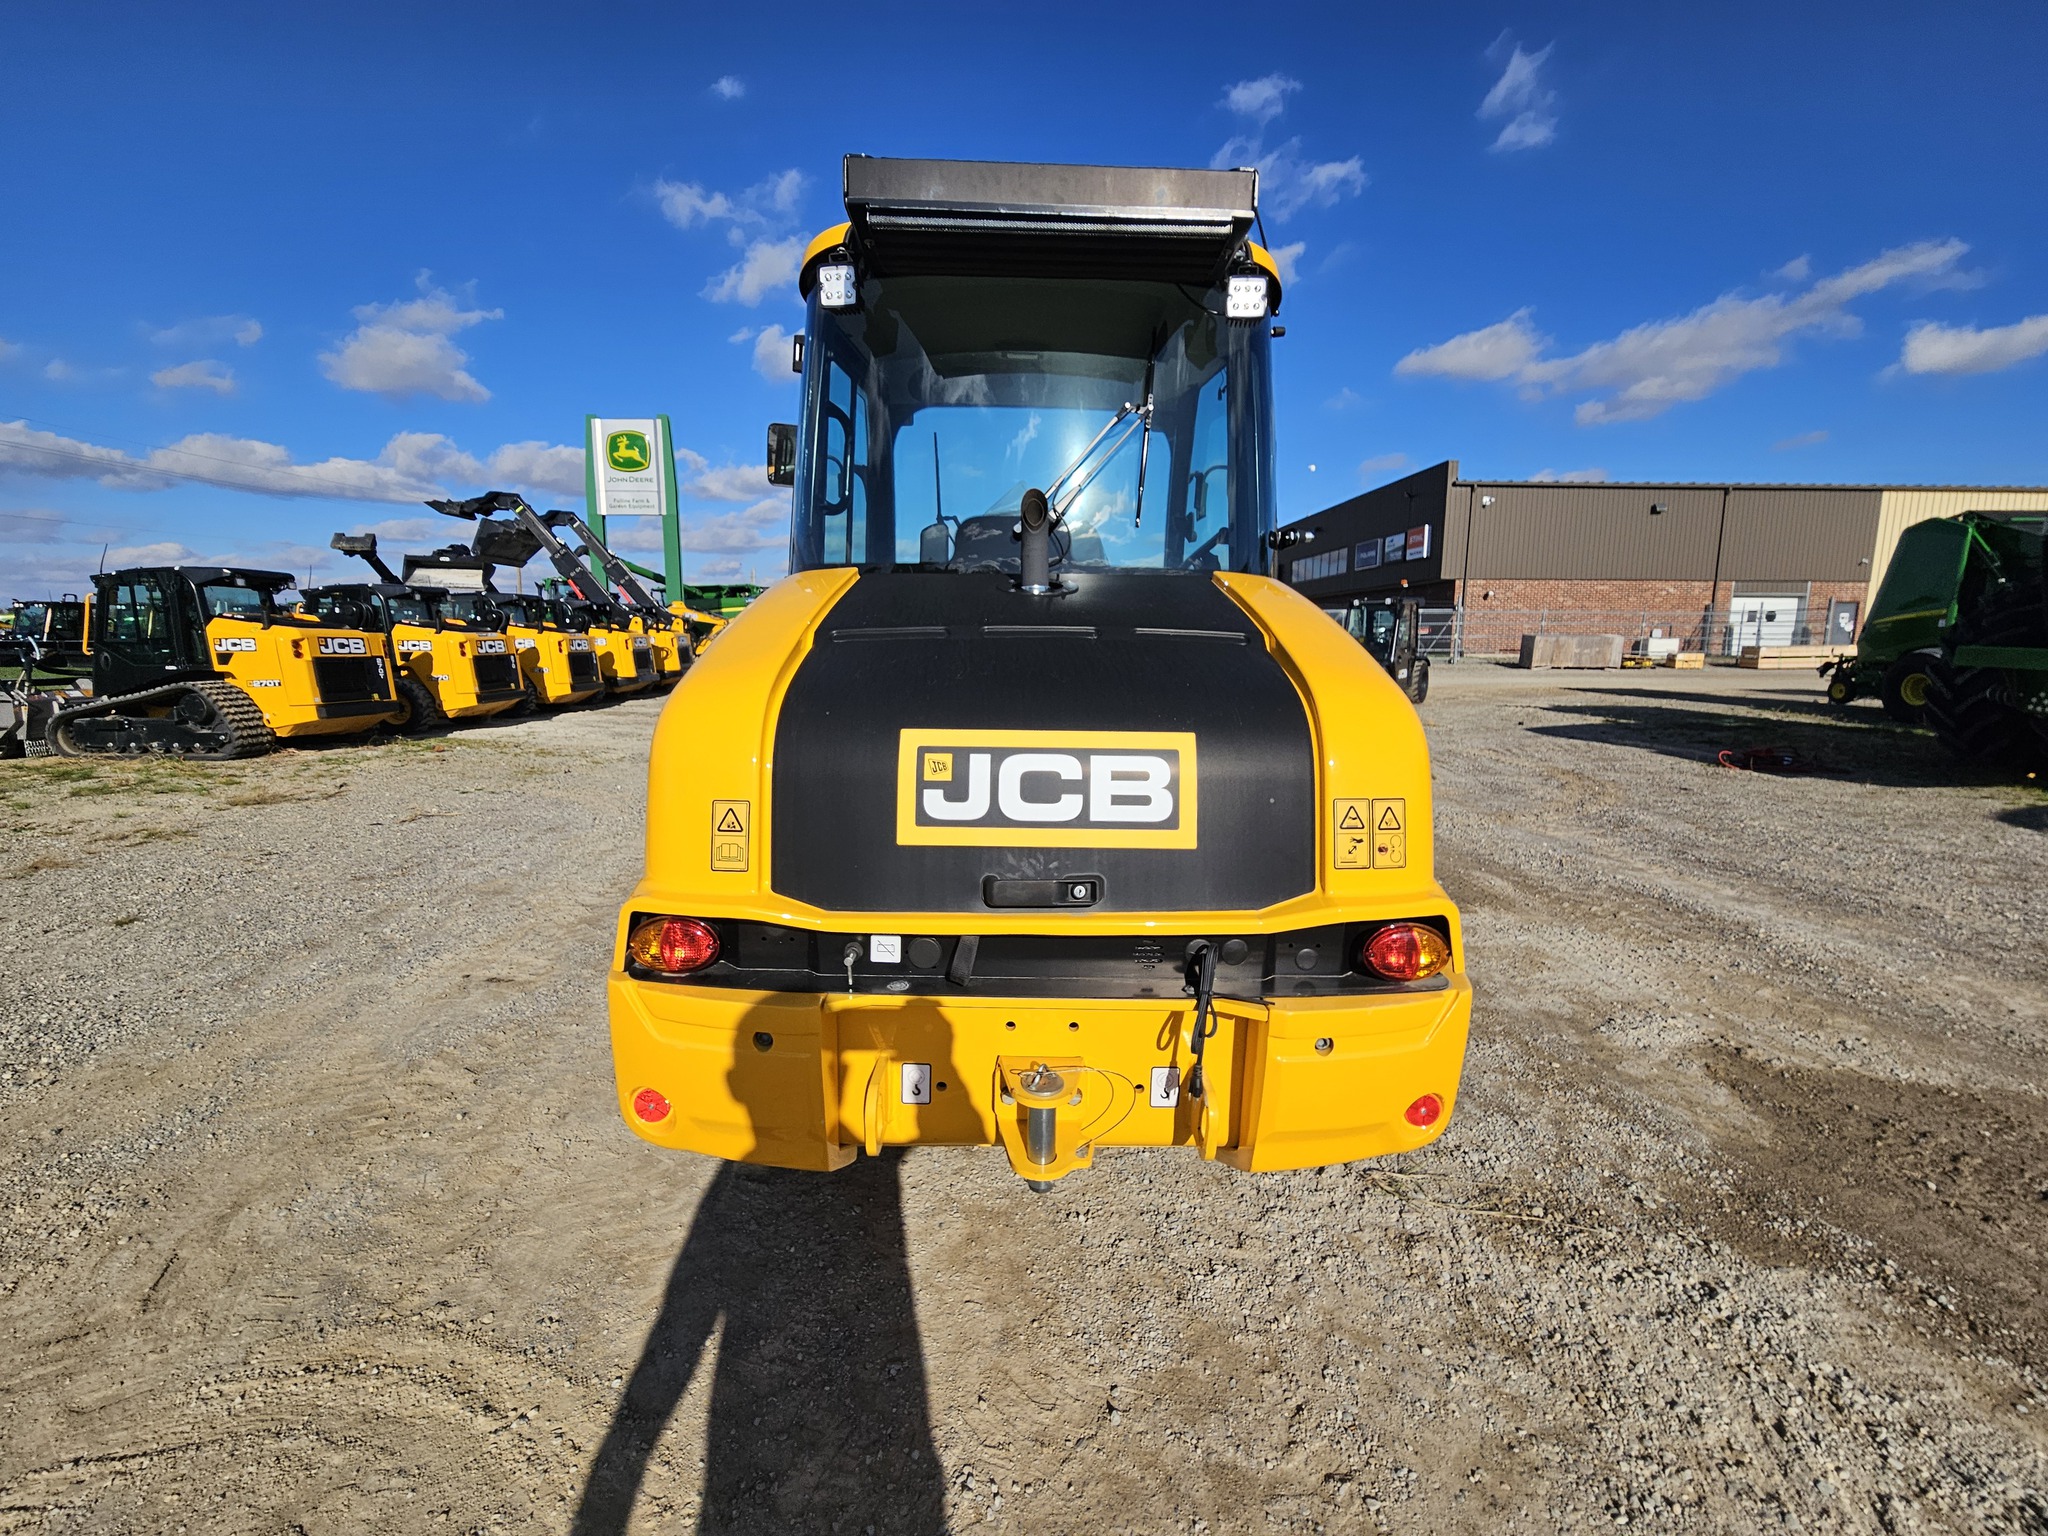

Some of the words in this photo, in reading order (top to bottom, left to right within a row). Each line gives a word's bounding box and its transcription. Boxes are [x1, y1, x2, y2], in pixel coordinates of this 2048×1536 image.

[214, 638, 257, 651] JCB
[320, 638, 366, 654] JCB
[398, 640, 432, 651] JCB
[478, 640, 506, 653] JCB
[515, 639, 535, 648] CB
[570, 639, 589, 650] JCB
[932, 761, 947, 773] JCB
[923, 753, 1173, 822] JCB
